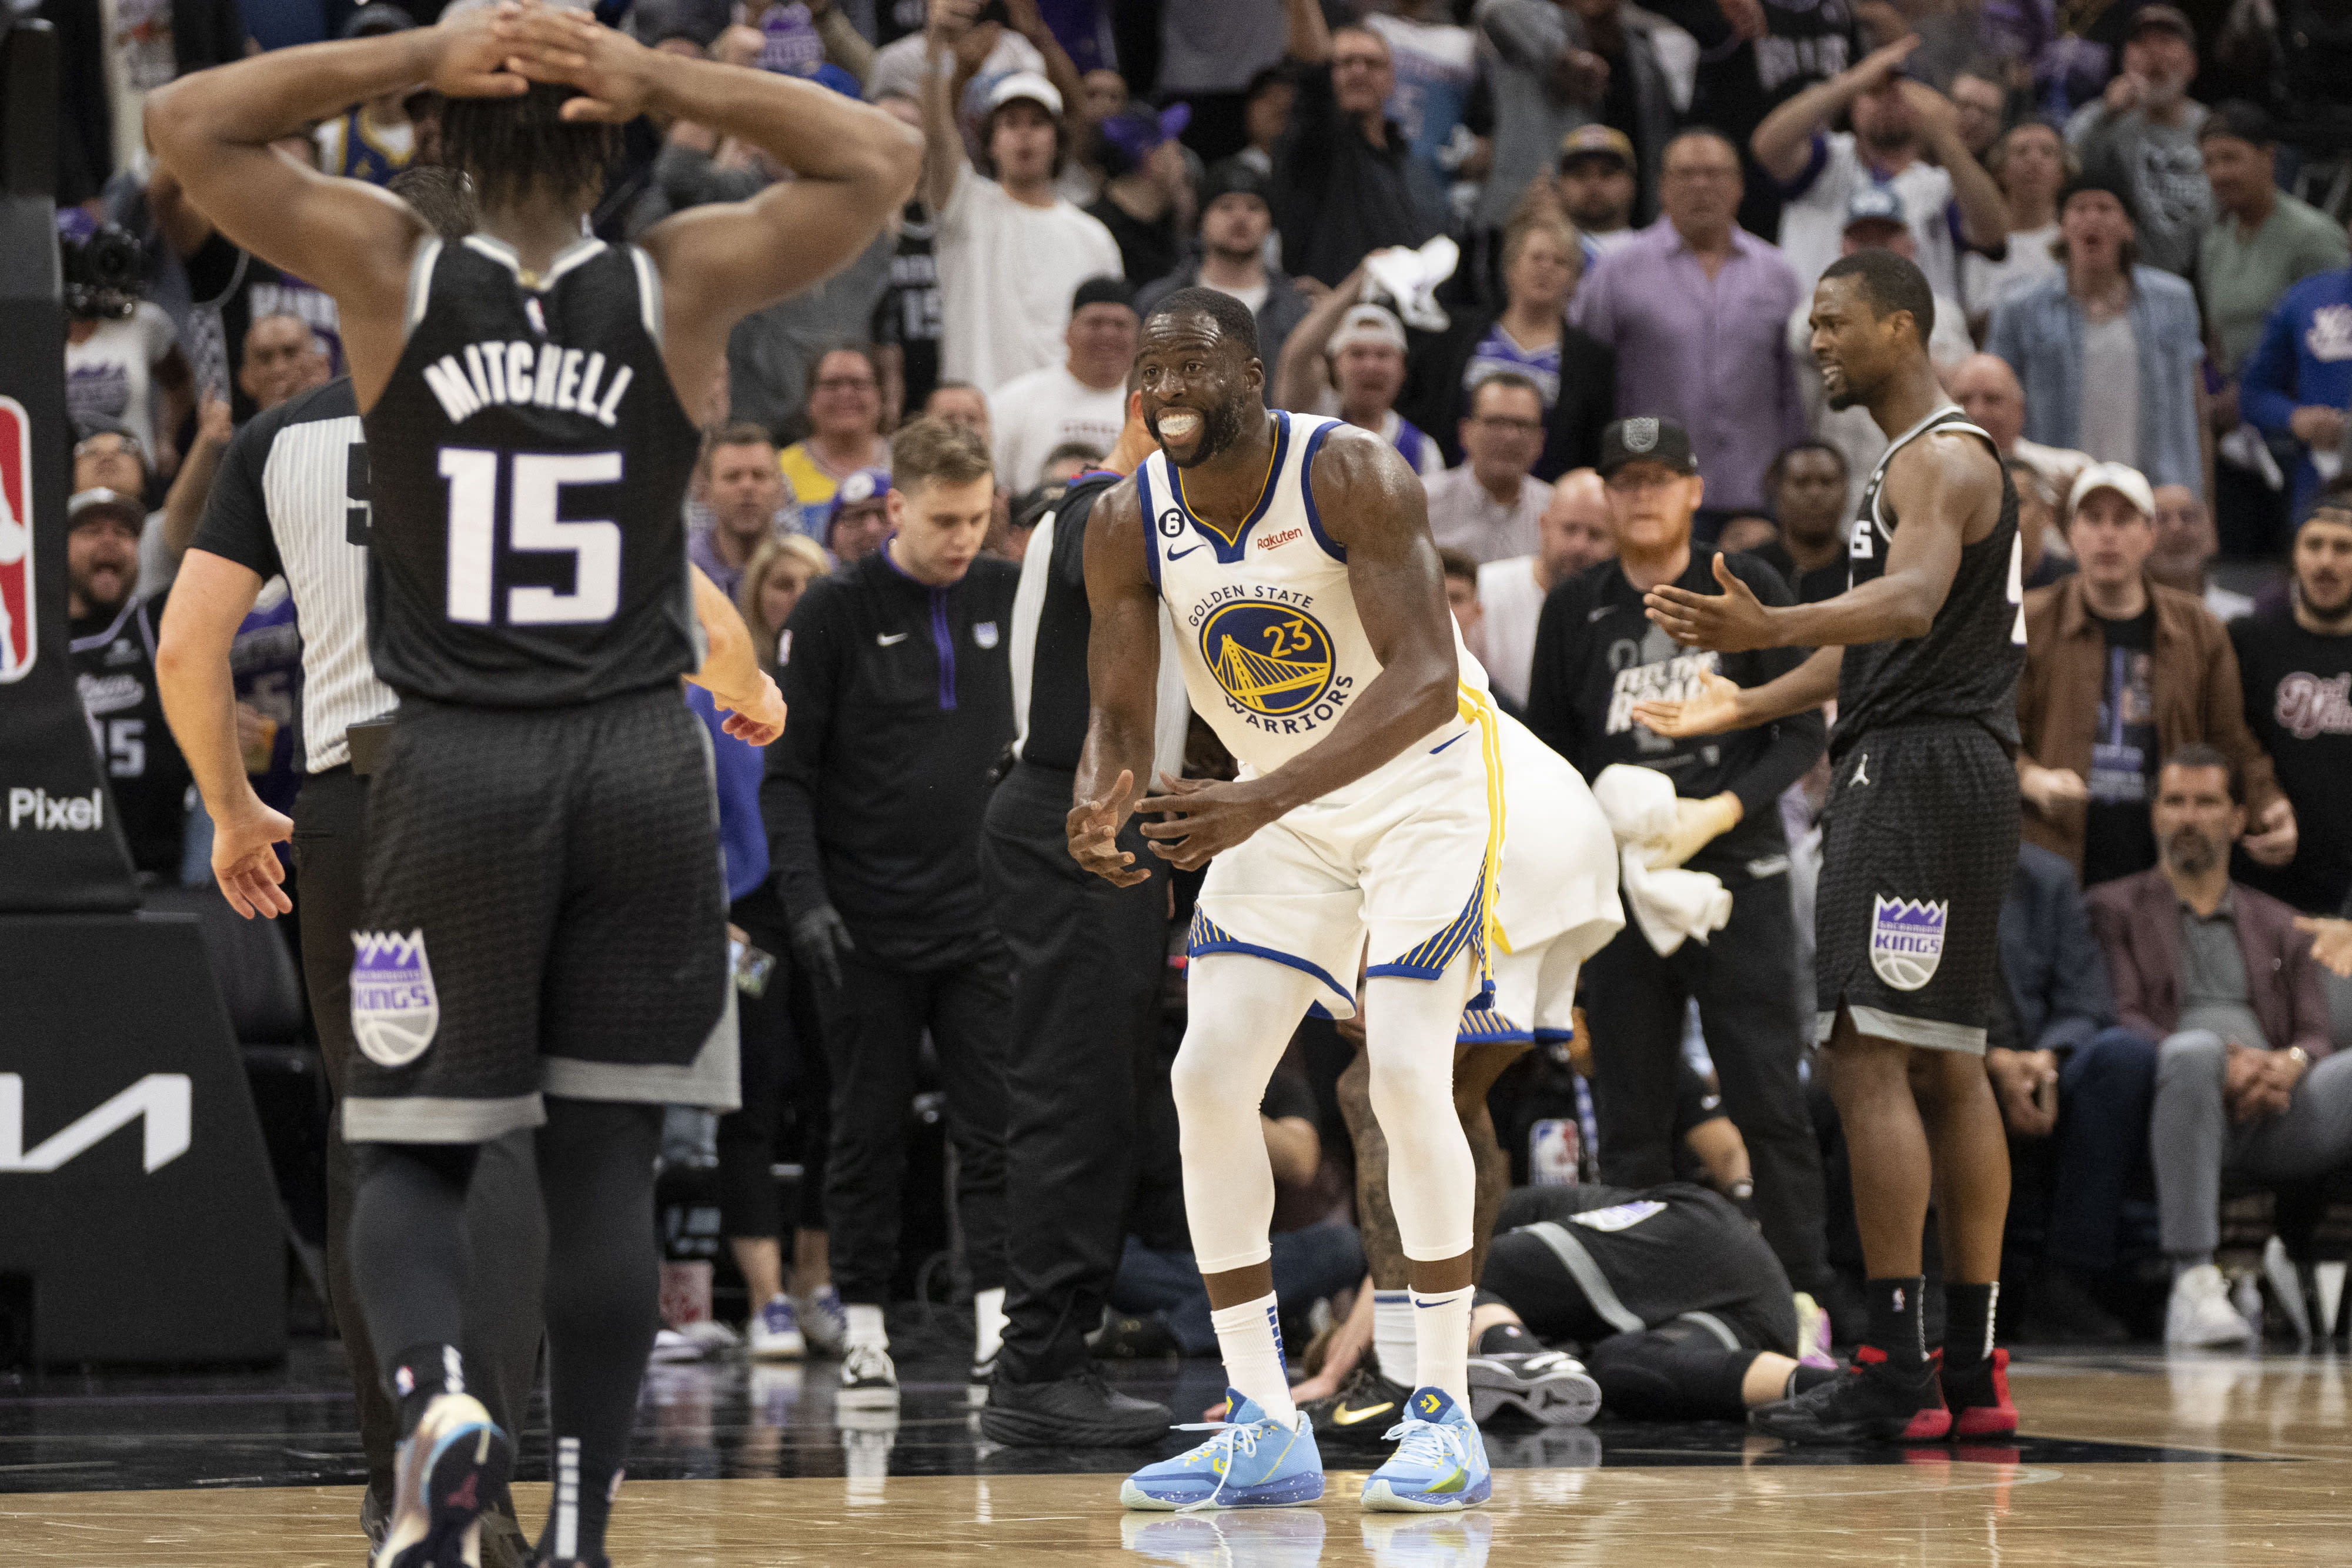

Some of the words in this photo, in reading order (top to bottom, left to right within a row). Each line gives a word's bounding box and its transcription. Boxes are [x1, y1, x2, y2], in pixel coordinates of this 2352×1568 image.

[422, 340, 634, 427] MITCHELL
[438, 447, 622, 629] 15
[1165, 511, 1180, 534] 6
[1257, 528, 1303, 550] Rakuten
[1188, 584, 1245, 627] GOLDEN
[1254, 585, 1314, 609] STATE
[1263, 619, 1312, 658] 23
[1225, 676, 1354, 734] WARRIORS
[9, 787, 103, 831] Pixel
[1875, 934, 1940, 954] KINGS
[354, 984, 430, 1009] KINGS
